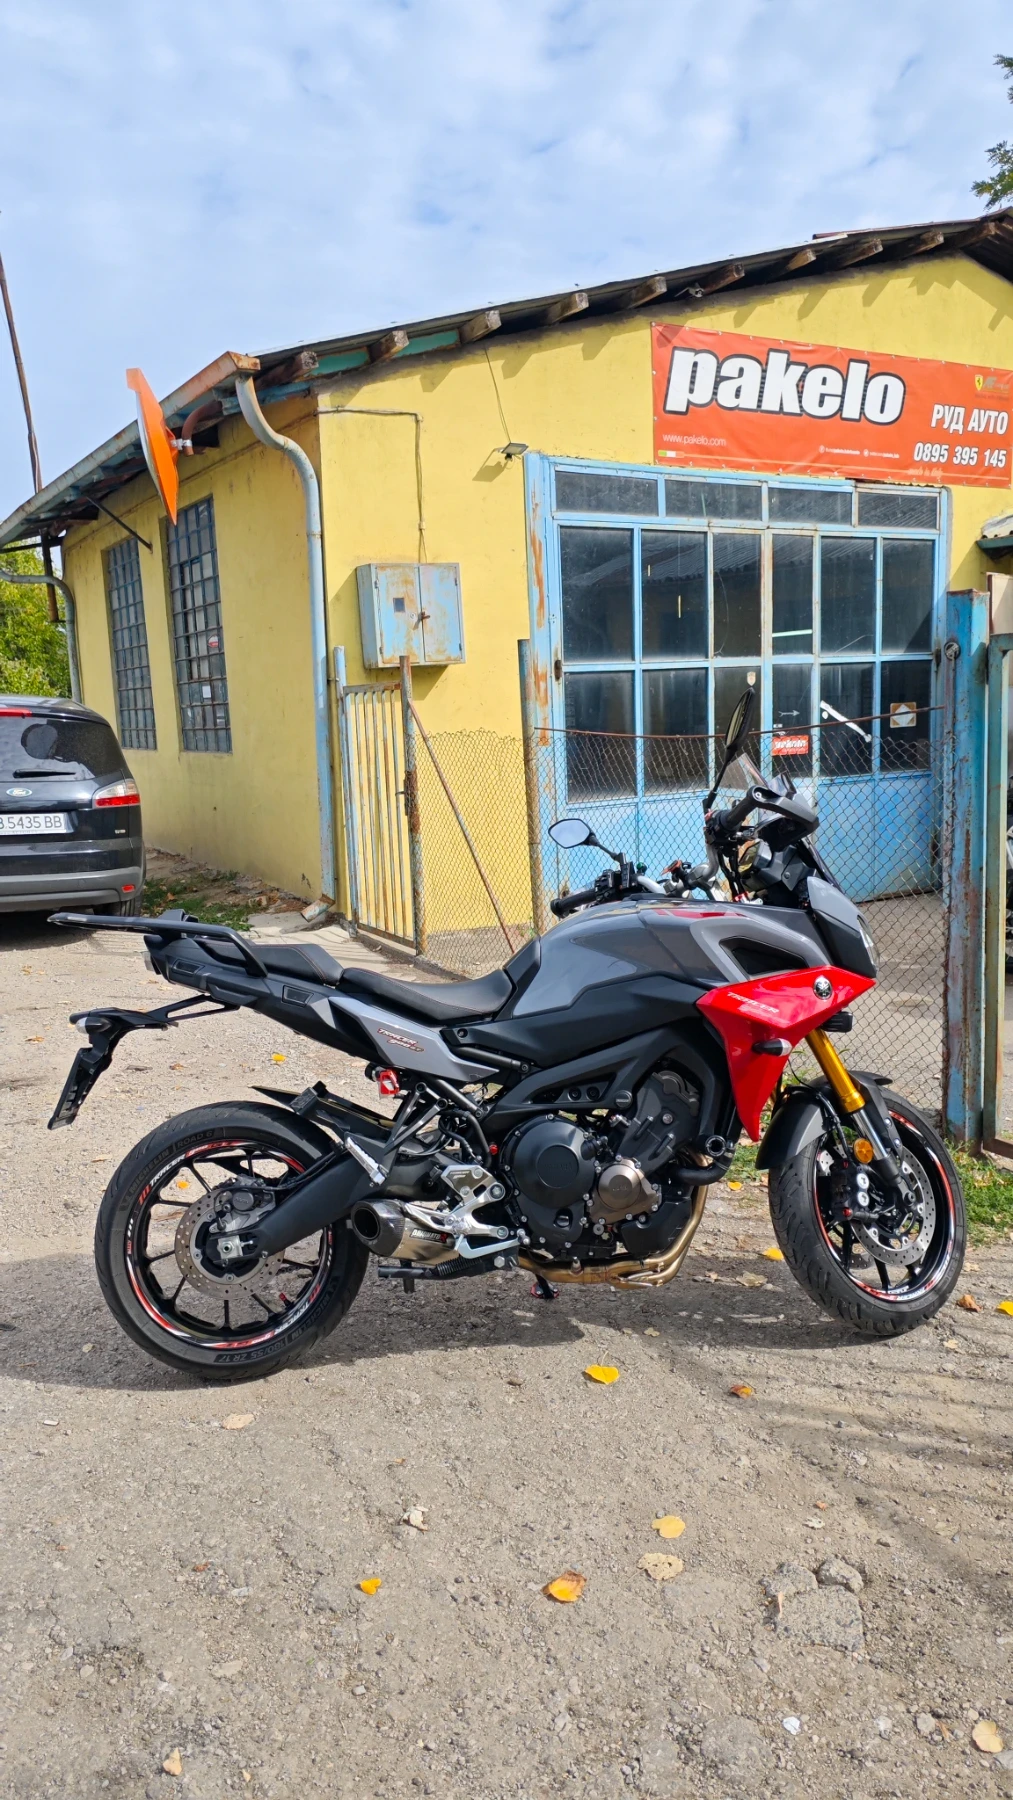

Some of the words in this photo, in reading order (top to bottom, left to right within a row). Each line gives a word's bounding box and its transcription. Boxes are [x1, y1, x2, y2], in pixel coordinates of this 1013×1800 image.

[665, 348, 905, 424] pakelo
[931, 404, 965, 434] РУД
[967, 408, 1008, 434] АУТО
[662, 434, 726, 446] www.pakelo.com
[914, 442, 949, 463] 0895
[953, 445, 978, 465] 395
[984, 448, 1006, 468] 145
[8, 815, 41, 830] 5435
[44, 815, 62, 829] BB
[128, 1148, 170, 1194] MICHELIN
[177, 1133, 204, 1149] ROAD
[206, 1130, 213, 1138] 6
[291, 1293, 331, 1341] MICHELIN
[234, 1353, 248, 1362] ZR
[251, 1340, 286, 1359] 180/55
